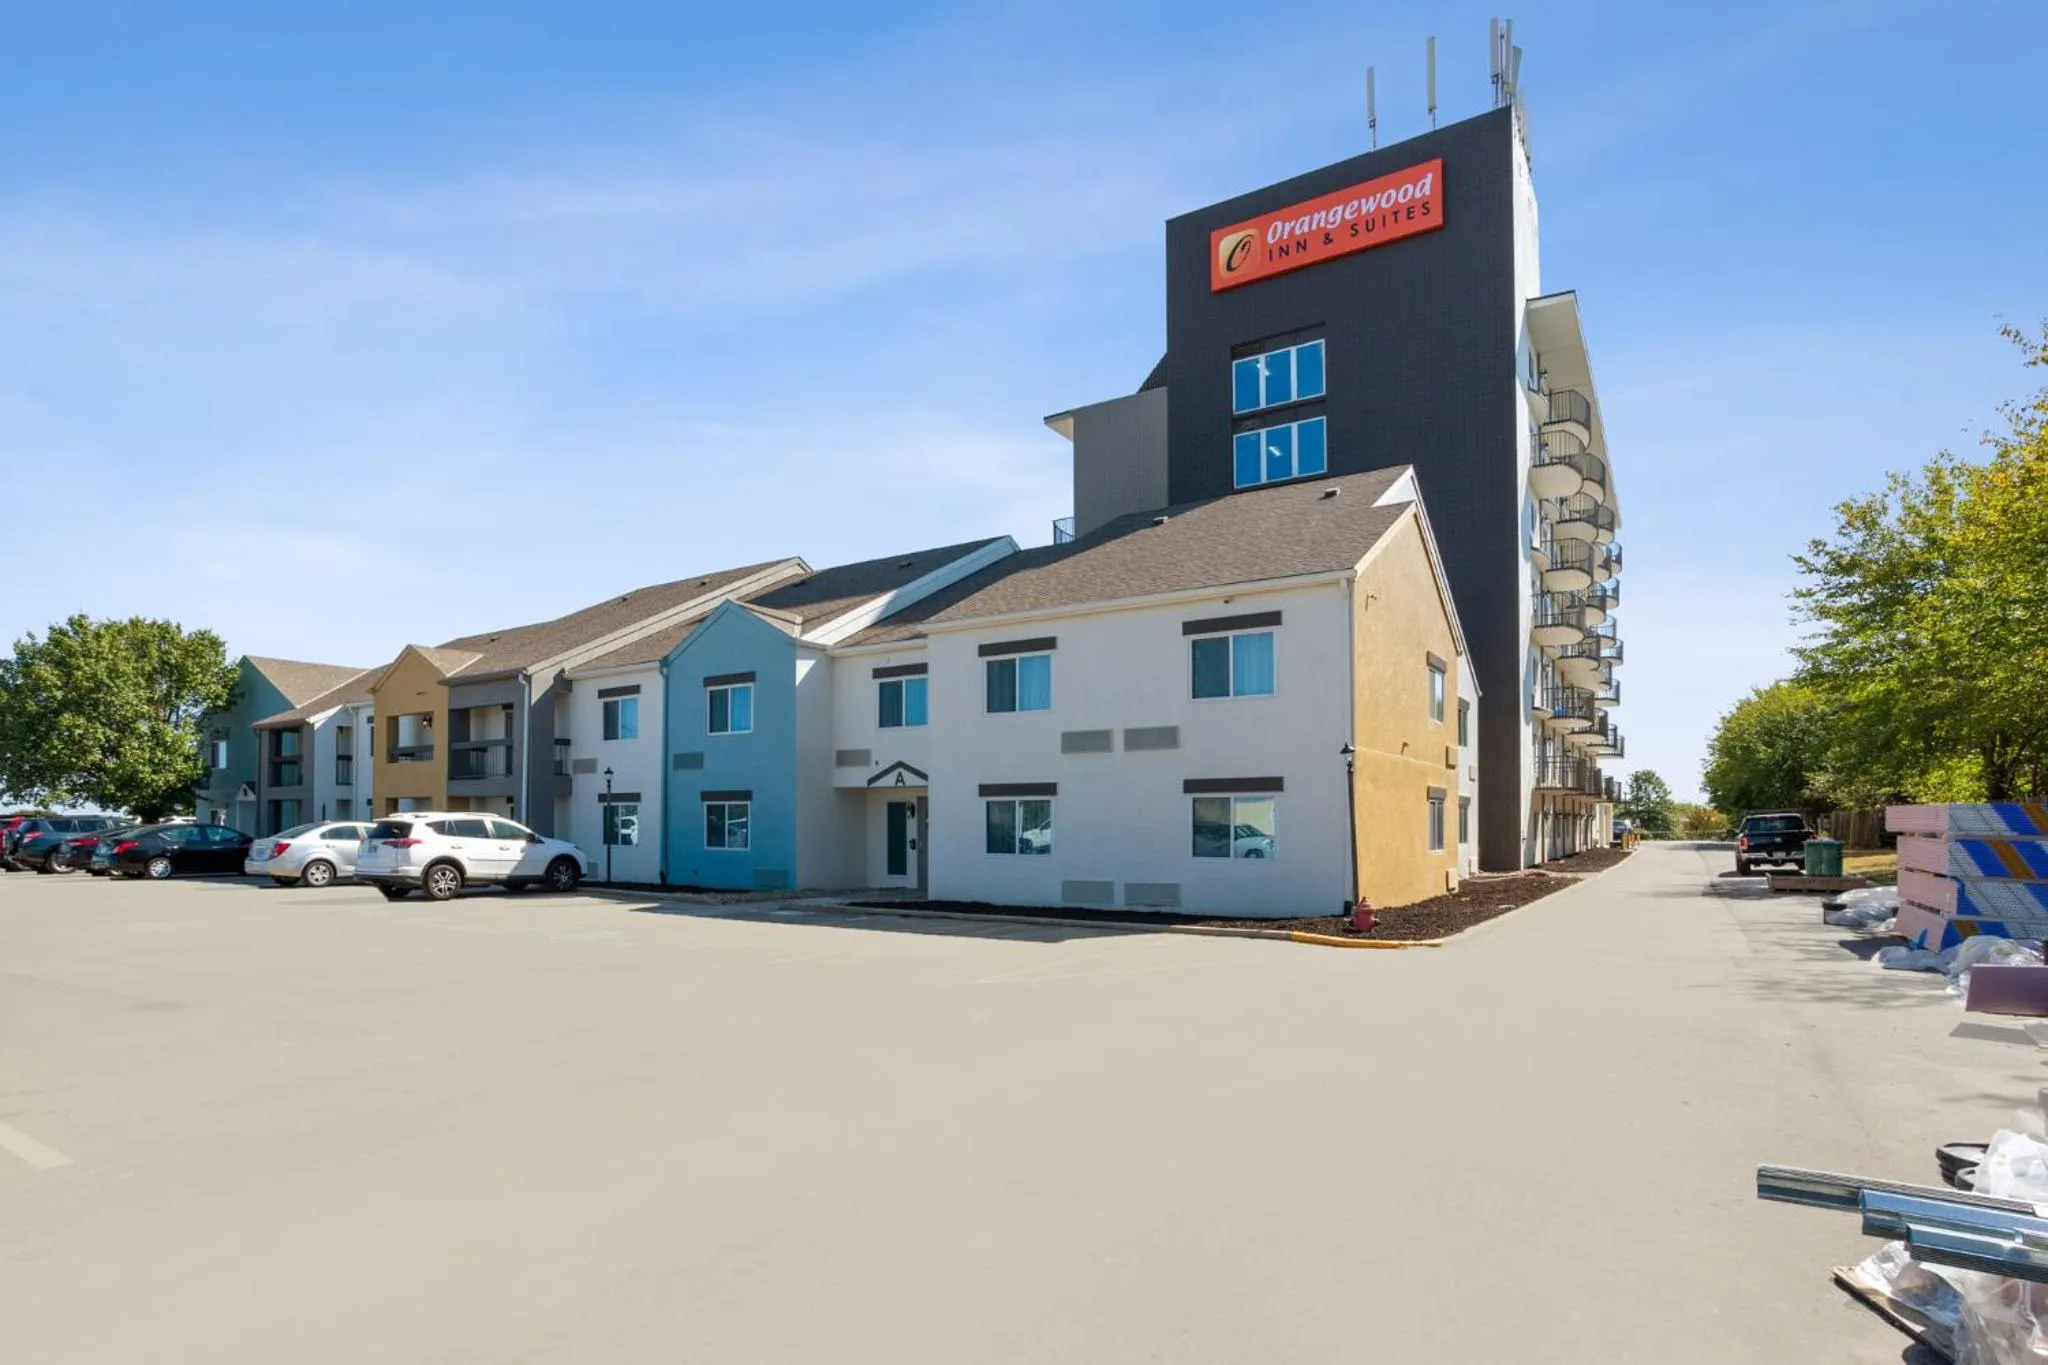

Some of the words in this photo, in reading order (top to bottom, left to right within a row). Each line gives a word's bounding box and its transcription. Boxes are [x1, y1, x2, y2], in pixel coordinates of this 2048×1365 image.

[1267, 172, 1433, 244] Orangewood
[1268, 238, 1308, 263] INN
[1323, 232, 1334, 246] &
[1350, 200, 1432, 239] SUITES
[894, 770, 906, 786] A
